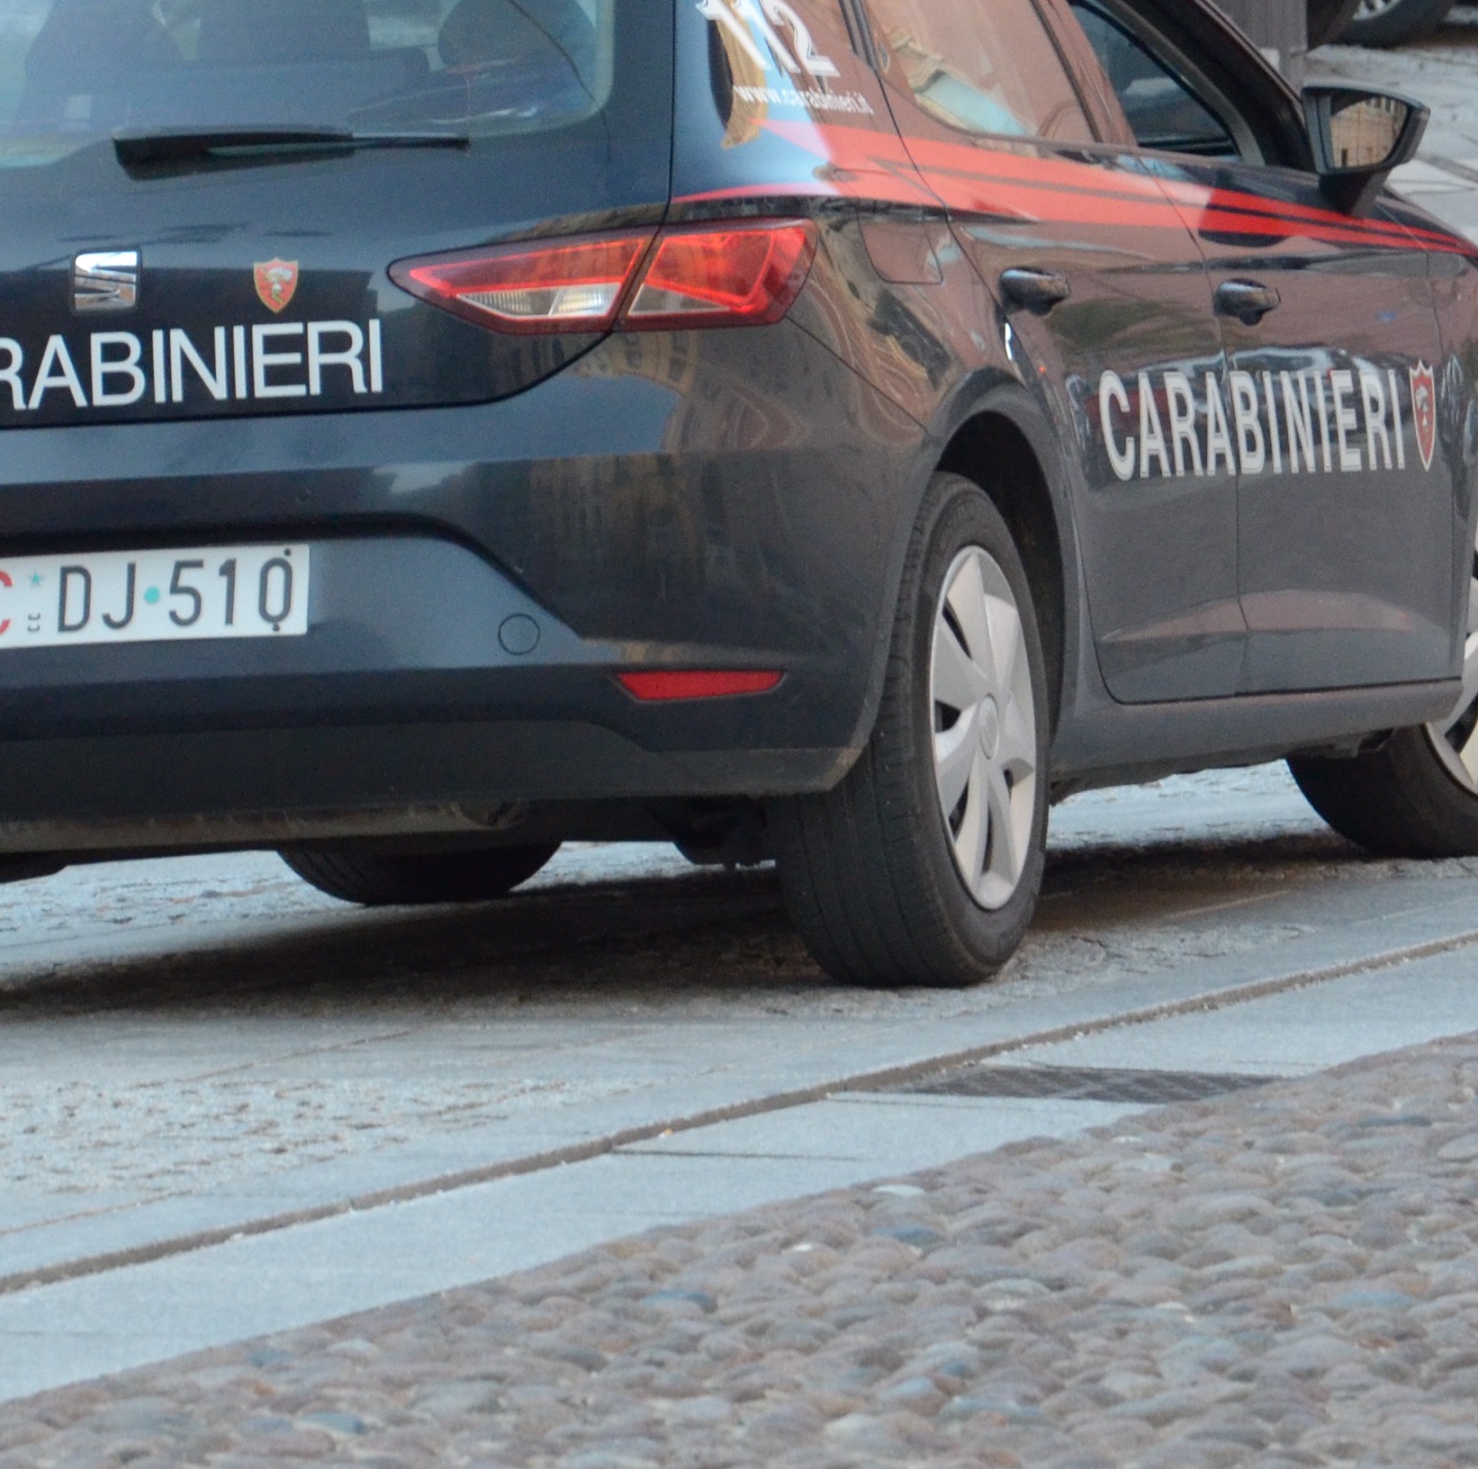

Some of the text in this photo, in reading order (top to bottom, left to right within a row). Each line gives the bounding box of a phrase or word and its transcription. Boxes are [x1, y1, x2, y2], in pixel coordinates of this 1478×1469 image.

[732, 84, 875, 115] www.carabinieri.it
[1098, 368, 1406, 482] CARABINIERI
[57, 561, 137, 633] DJ
